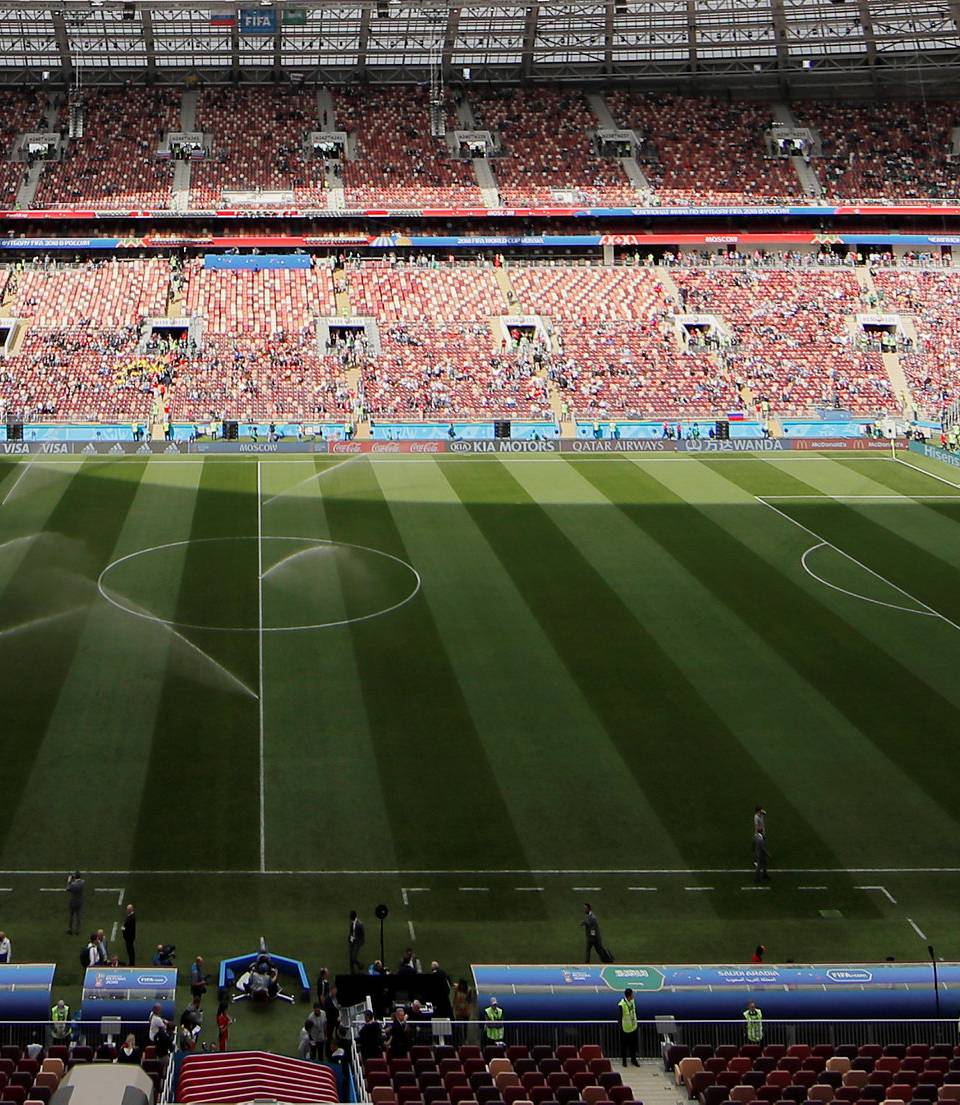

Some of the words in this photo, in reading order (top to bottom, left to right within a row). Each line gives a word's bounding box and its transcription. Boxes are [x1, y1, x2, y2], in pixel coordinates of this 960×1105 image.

[245, 16, 271, 27] FIFA
[3, 443, 30, 454] VISA
[41, 443, 68, 454] VISA
[240, 443, 278, 452] MOSCOW
[474, 442, 496, 452] KIA
[500, 442, 554, 452] MOTORS
[572, 441, 613, 452] QATAR
[614, 441, 664, 451] AIRWAYS
[733, 440, 783, 451] WANDA
